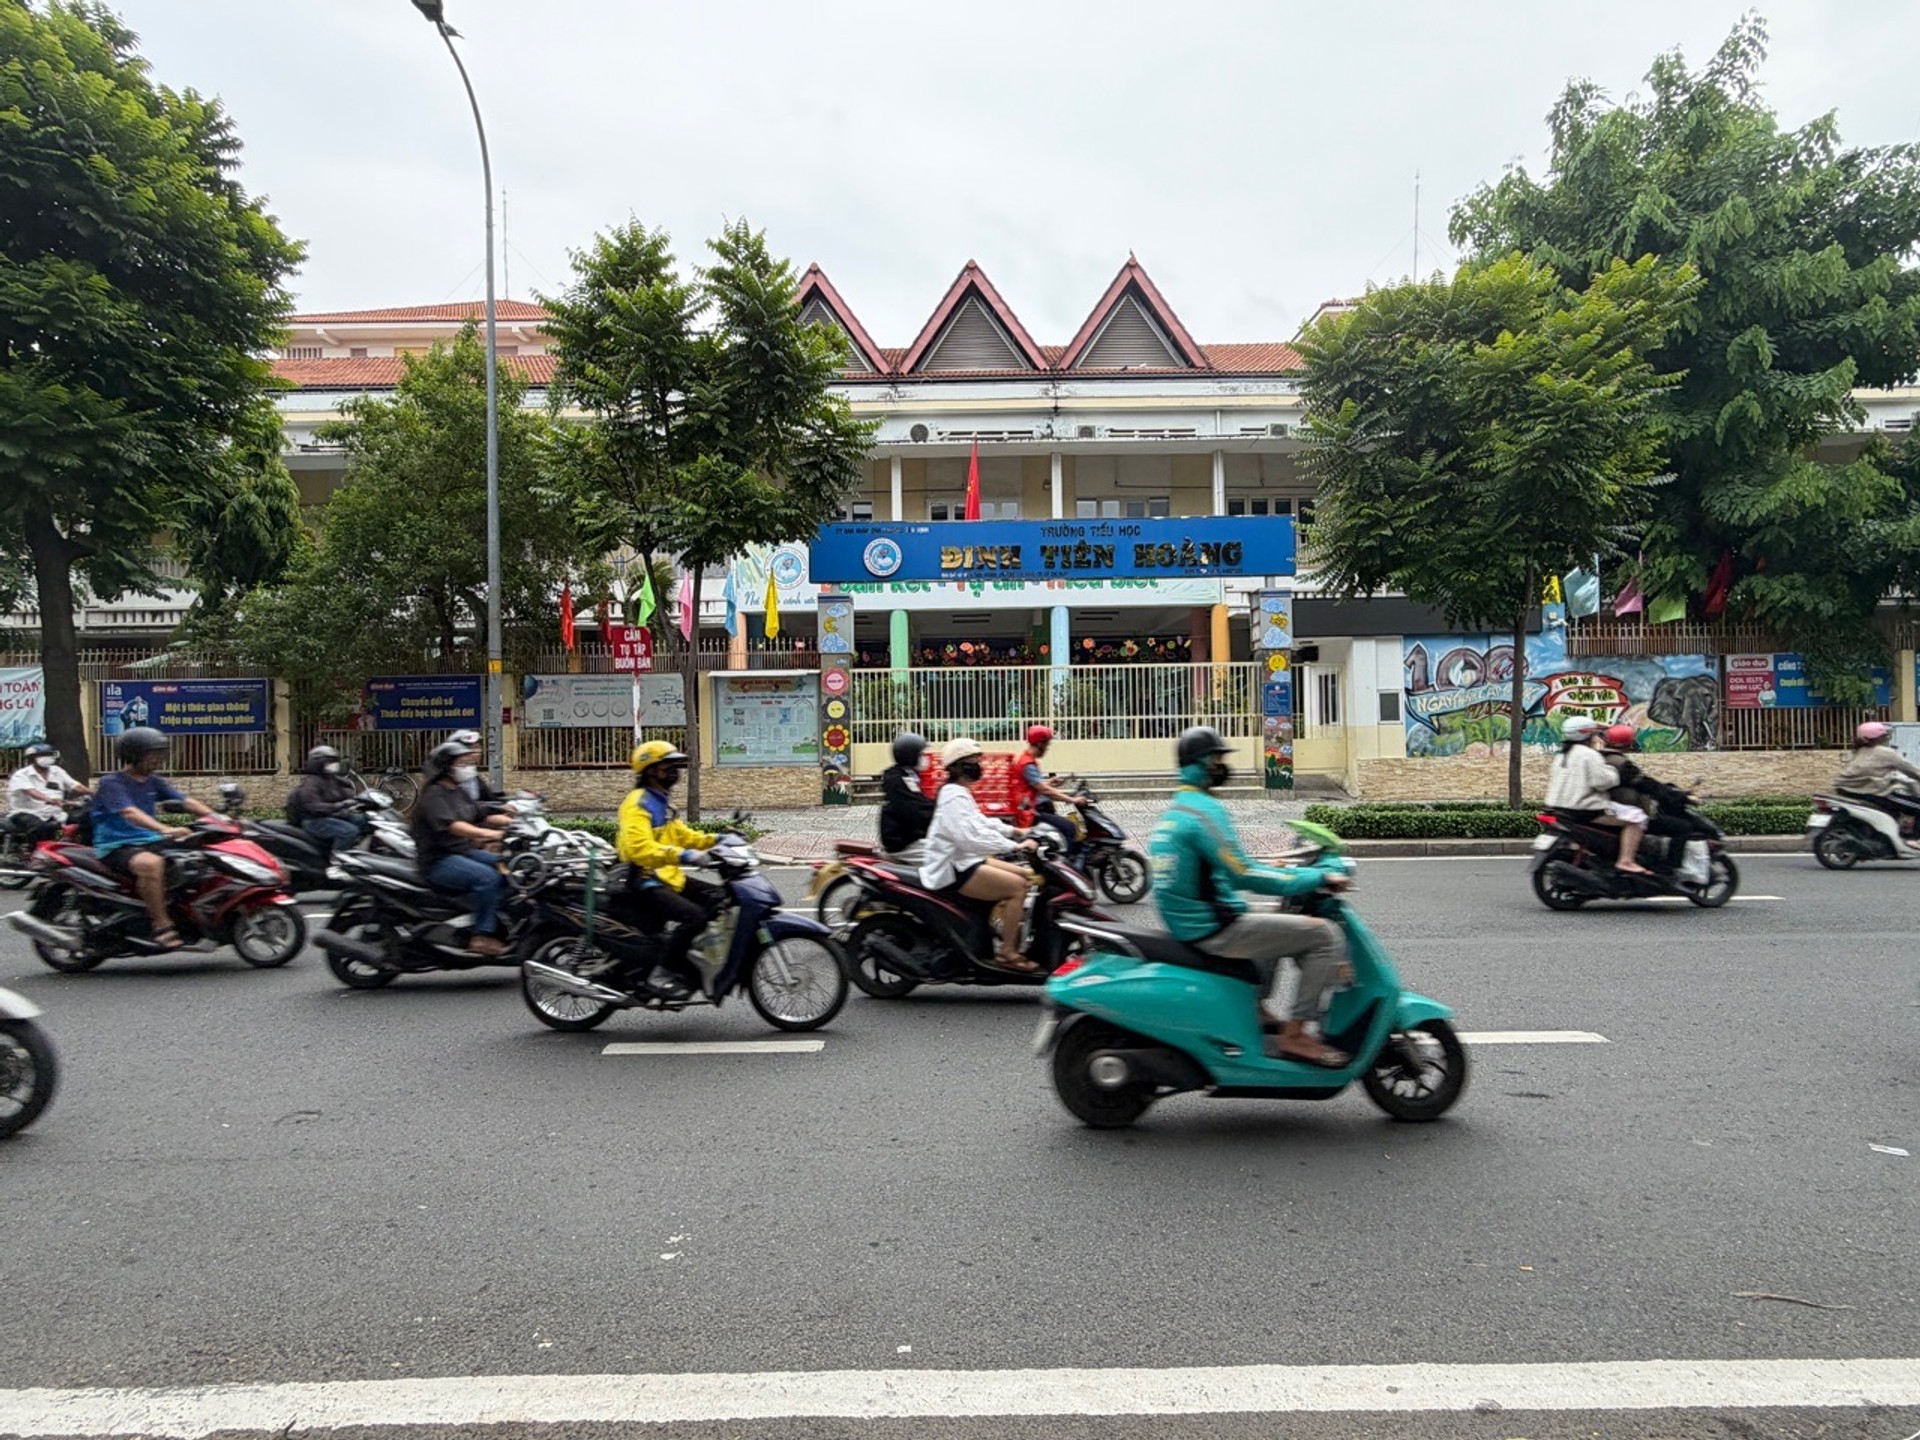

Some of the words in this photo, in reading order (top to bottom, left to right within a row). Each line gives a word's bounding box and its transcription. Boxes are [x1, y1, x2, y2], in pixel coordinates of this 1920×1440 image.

[1040, 524, 1085, 537] TRƯỜNG
[1119, 525, 1141, 539] HỌC
[940, 544, 1022, 570] ĐINH
[1040, 538, 1116, 569] TIÊN
[1134, 536, 1243, 568] HOÀNG
